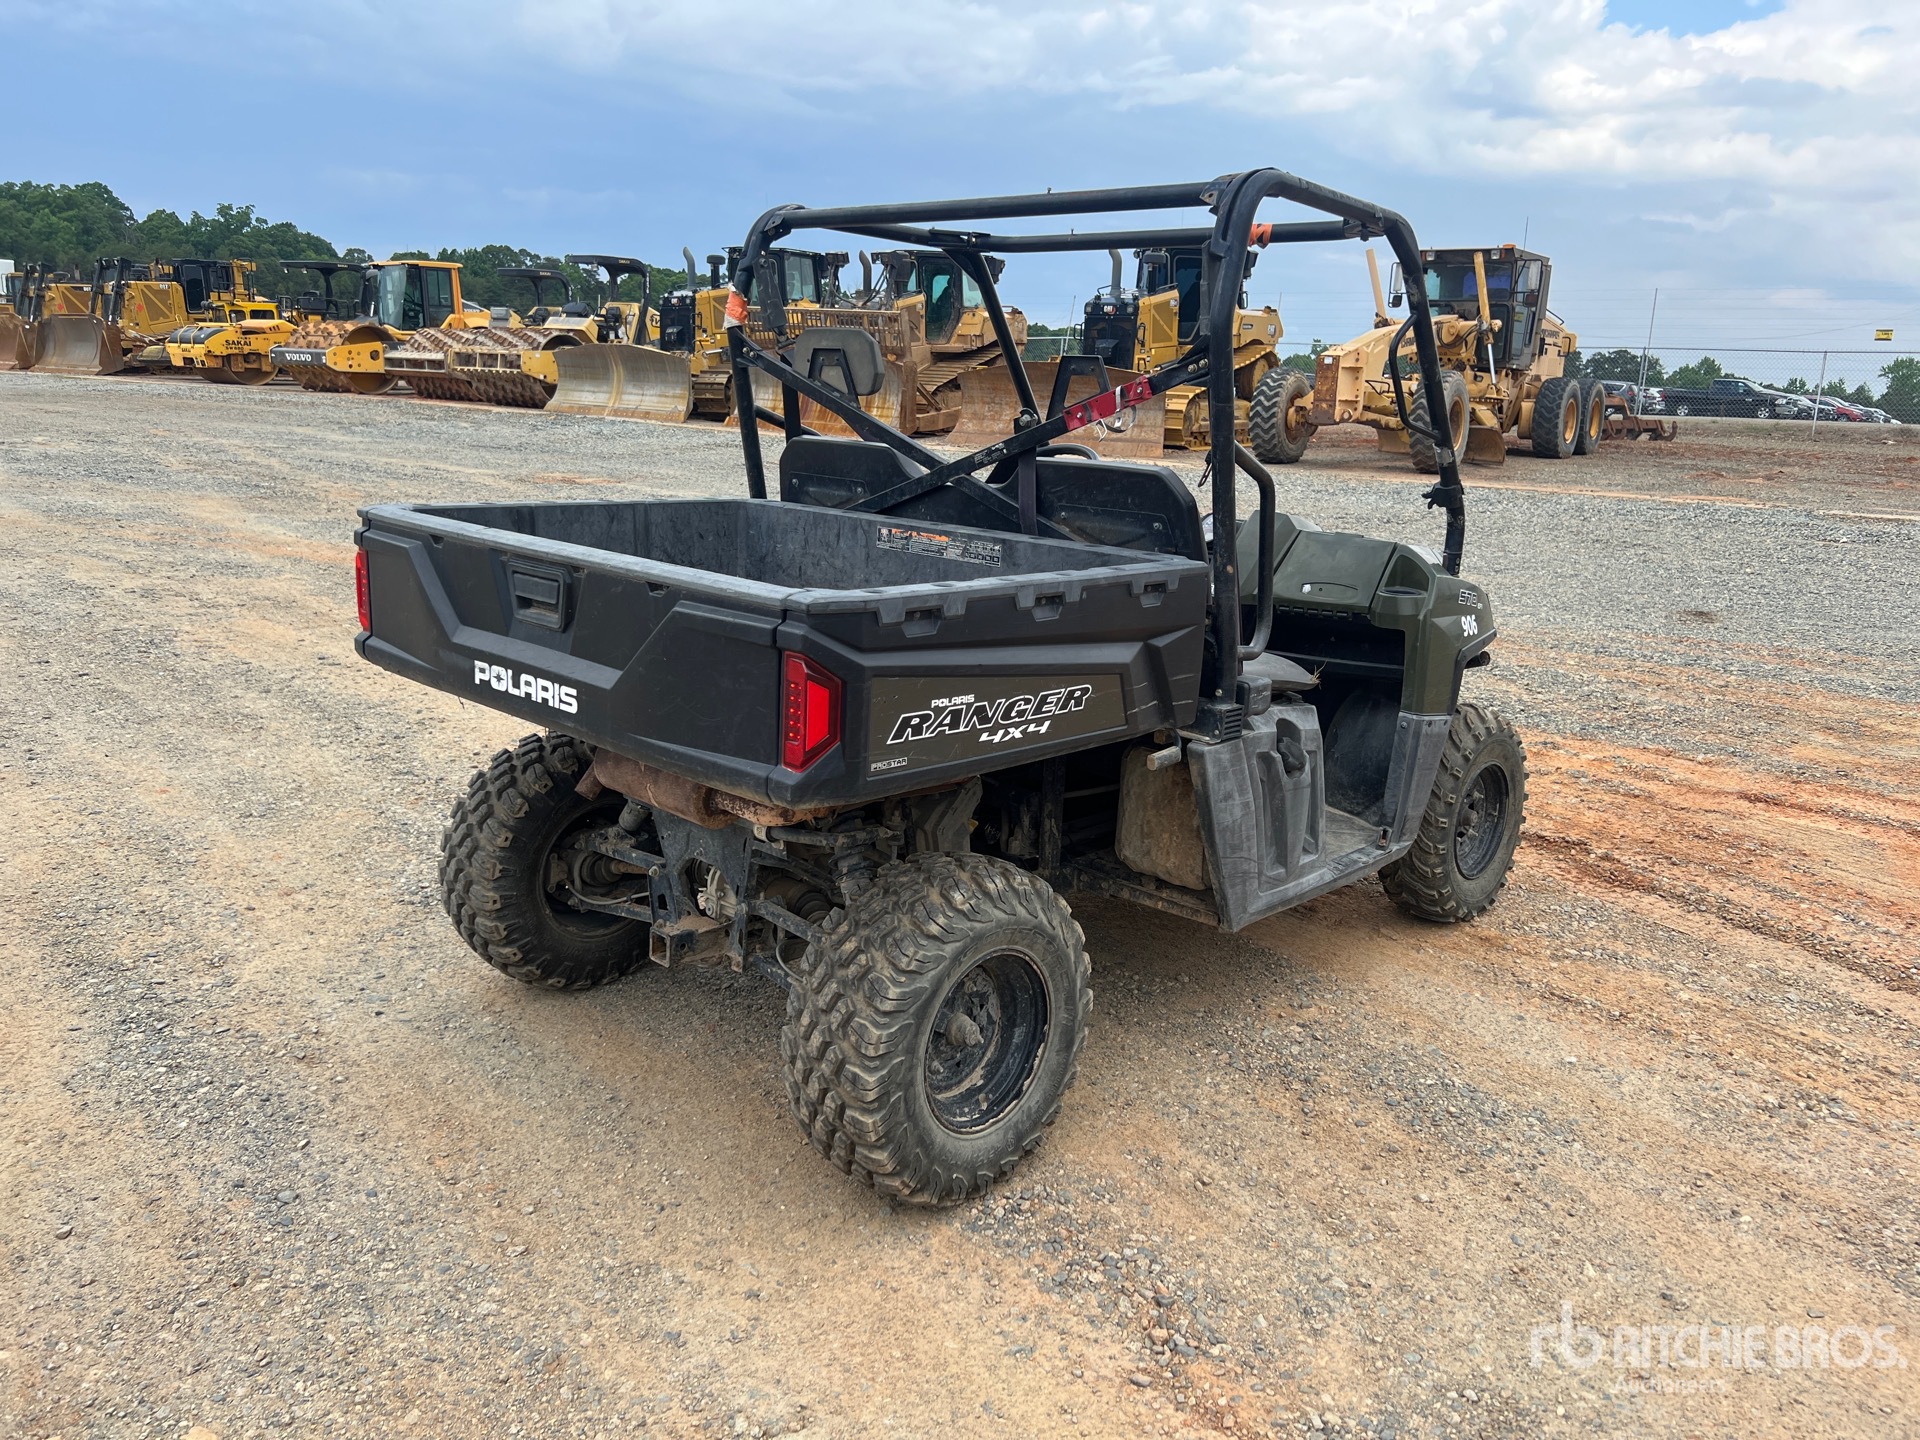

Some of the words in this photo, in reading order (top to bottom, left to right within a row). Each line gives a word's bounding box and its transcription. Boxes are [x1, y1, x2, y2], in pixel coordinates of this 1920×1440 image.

[285, 353, 312, 362] VOLVO
[1461, 614, 1478, 637] 906
[473, 659, 579, 715] POLARIS
[931, 694, 975, 709] POLARIS
[886, 684, 1093, 745] RANGER
